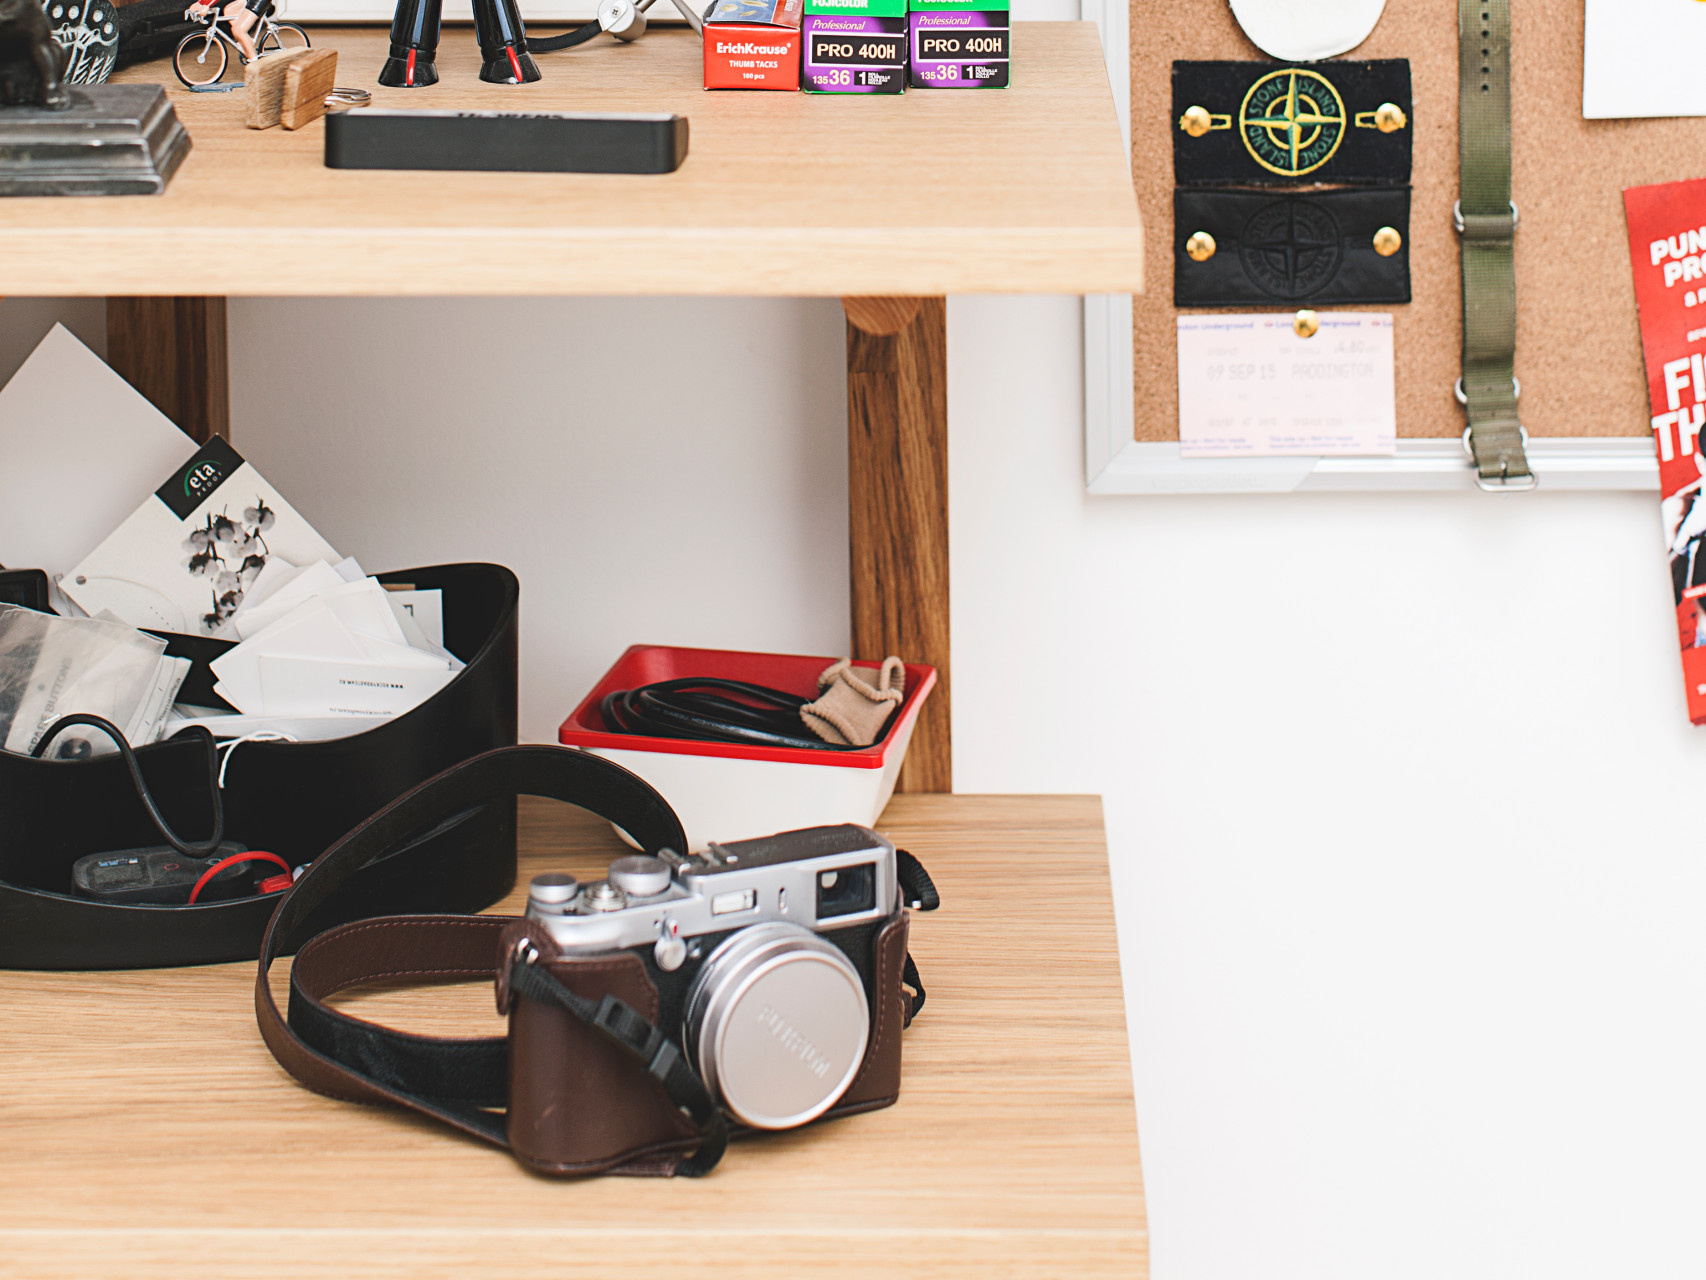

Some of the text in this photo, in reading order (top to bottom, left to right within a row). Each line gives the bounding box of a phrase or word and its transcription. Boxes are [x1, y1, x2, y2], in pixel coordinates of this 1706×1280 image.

[812, 19, 866, 30] Professional
[918, 15, 972, 25] Professional
[816, 43, 896, 59] PRO 400H
[923, 37, 1002, 53] PRO 400H
[729, 59, 778, 69] THUMB TACKS
[920, 71, 936, 80] 135
[936, 64, 958, 81] 36
[966, 65, 974, 79] 1
[812, 75, 829, 85] 135
[829, 69, 851, 86] 36
[858, 71, 866, 85] 1
[1248, 78, 1337, 116] STONE ISLAND
[1248, 126, 1337, 167] STONE ISLAND
[1650, 225, 1706, 266] PUN
[1291, 361, 1374, 381] PADDINGTON
[1663, 352, 1706, 411] FI
[1651, 402, 1706, 462] TH
[190, 464, 216, 489] eta
